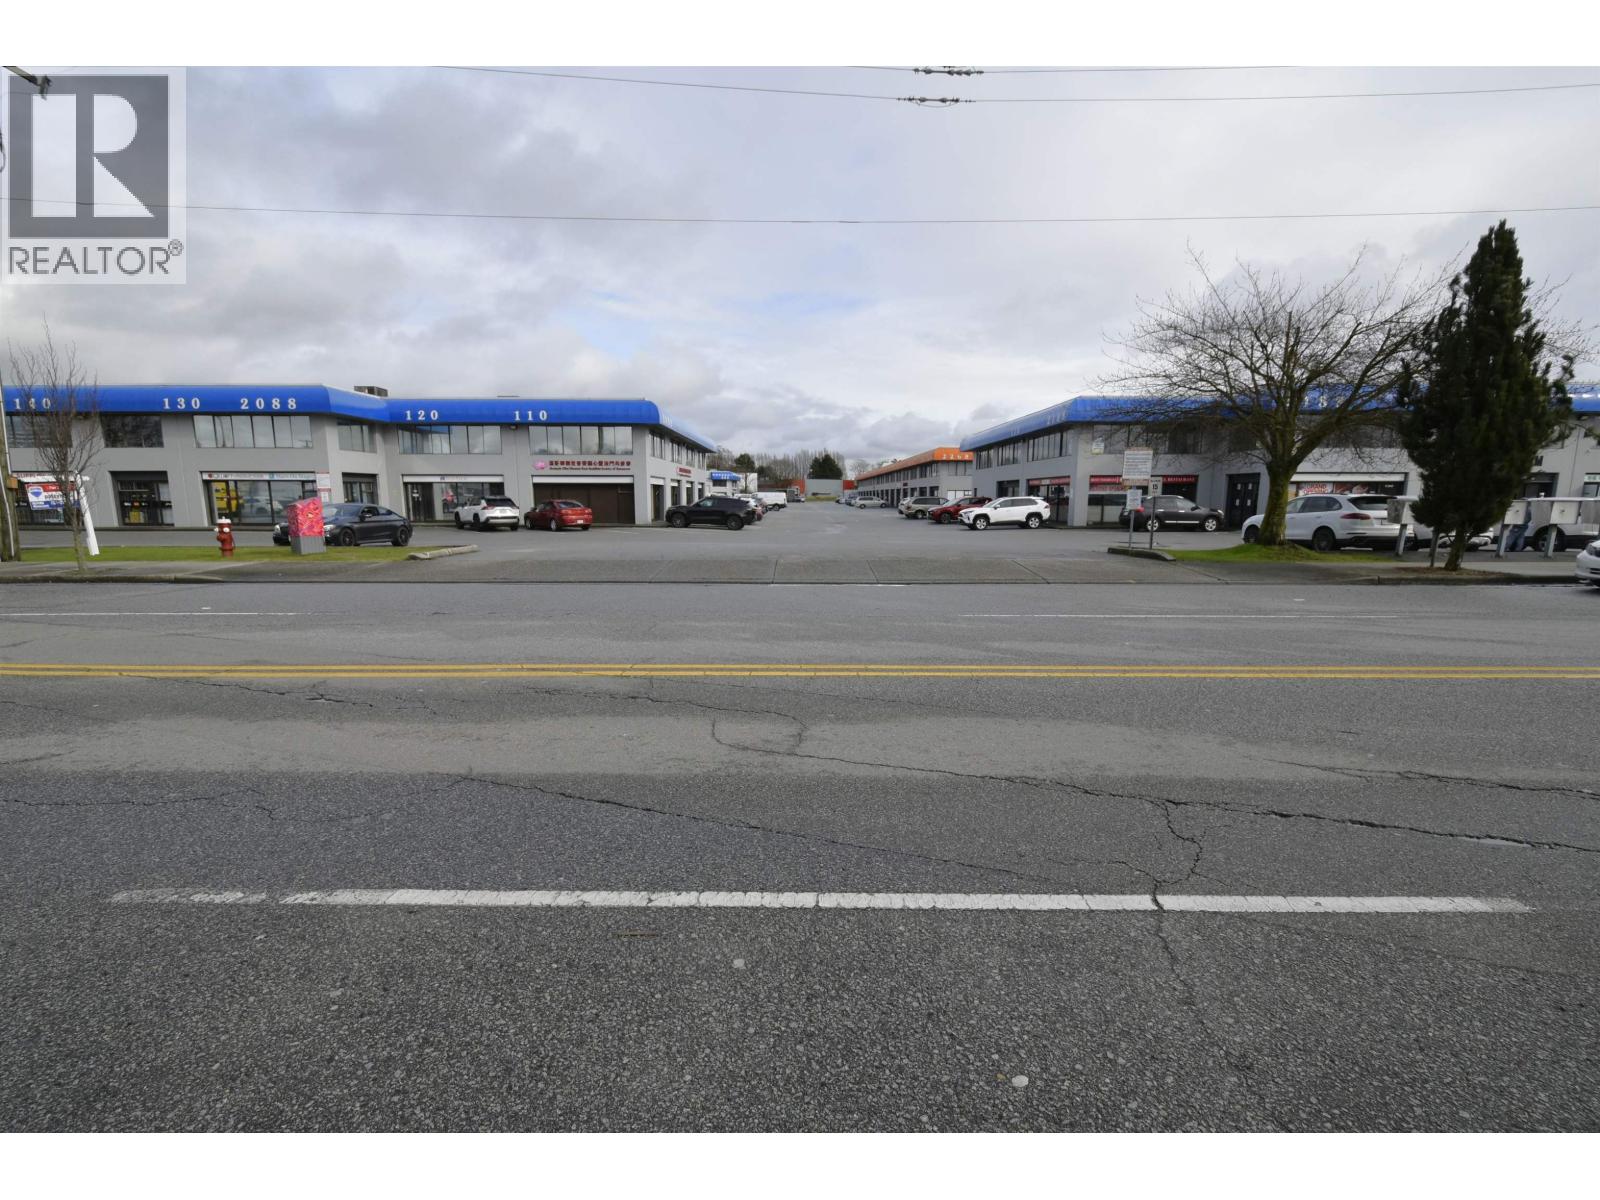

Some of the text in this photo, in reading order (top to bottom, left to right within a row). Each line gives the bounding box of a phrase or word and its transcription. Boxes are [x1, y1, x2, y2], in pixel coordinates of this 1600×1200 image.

[163, 397, 200, 410] 130
[240, 397, 297, 410] 2088
[405, 409, 439, 421] 120
[514, 410, 548, 421] 110
